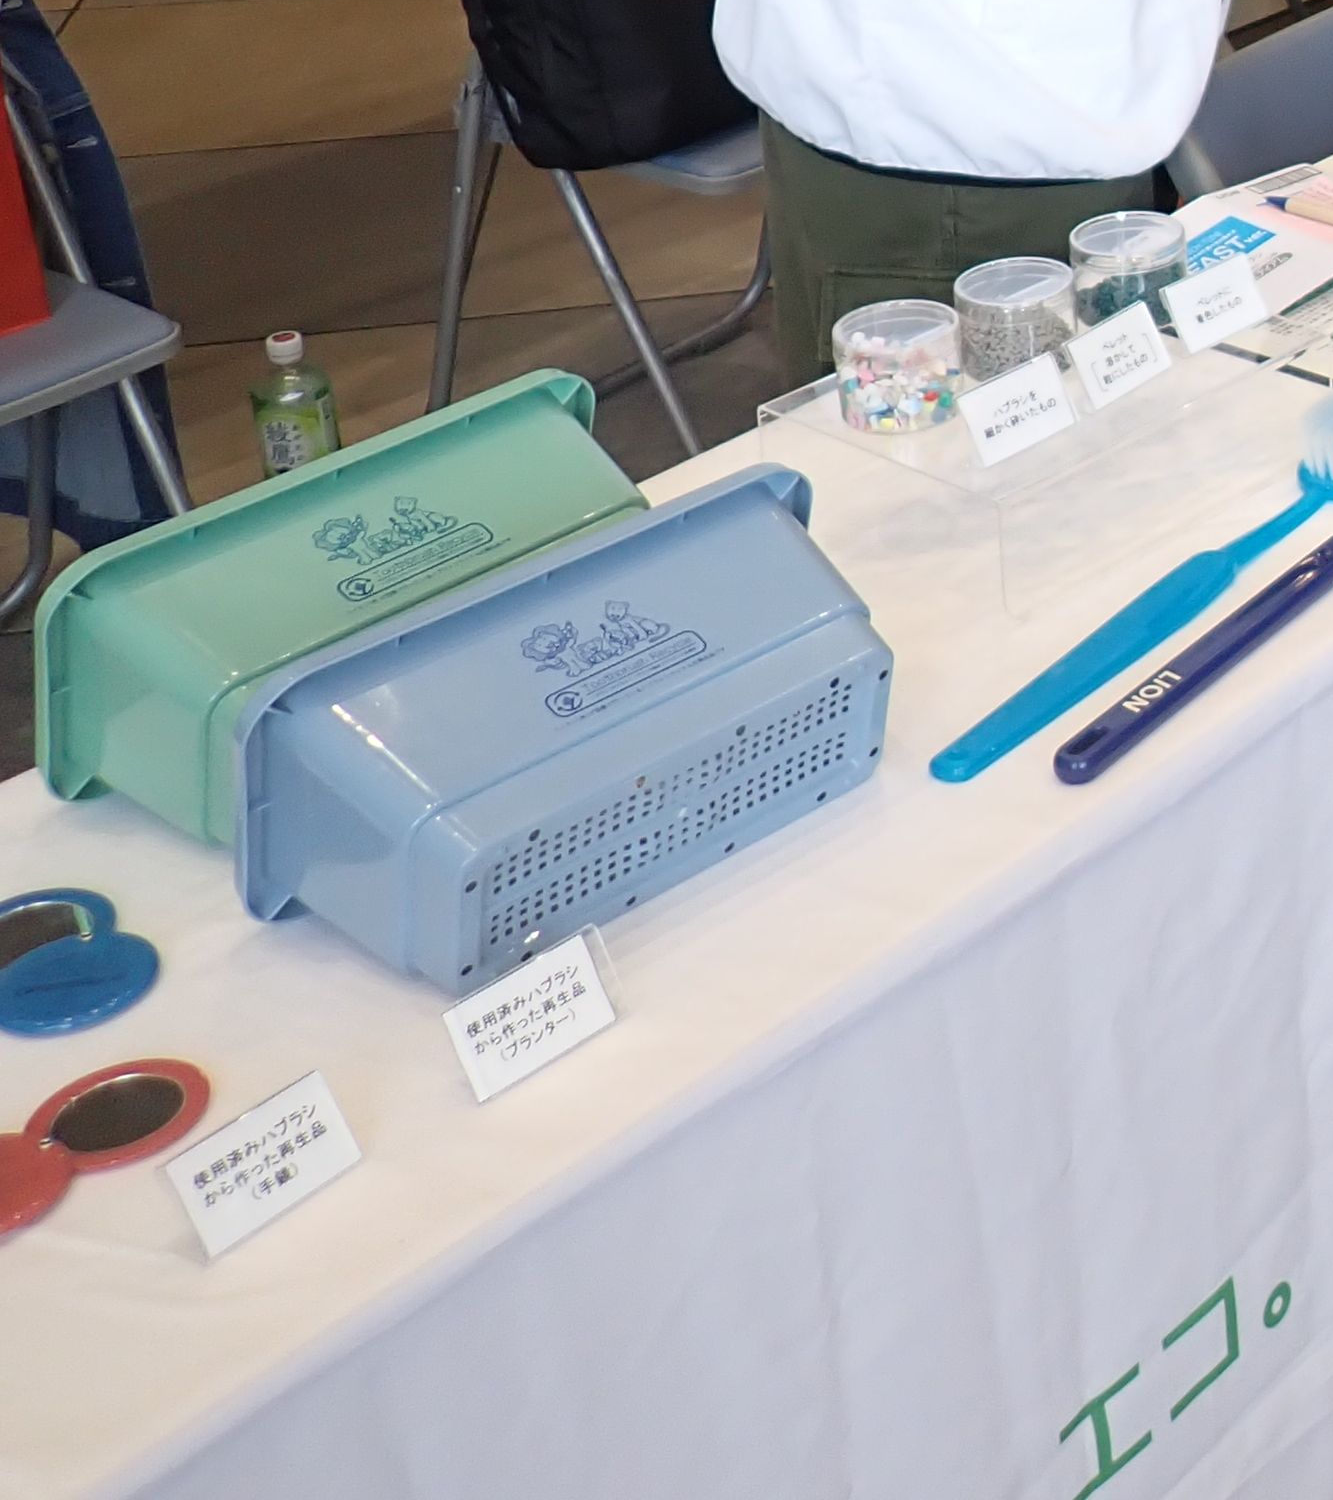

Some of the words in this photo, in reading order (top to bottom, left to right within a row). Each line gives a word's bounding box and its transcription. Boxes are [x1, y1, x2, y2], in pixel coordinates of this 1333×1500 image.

[1121, 669, 1182, 713] LION
[465, 965, 579, 1038] 使用済みハブラシ
[473, 980, 587, 1056] から作った再生品
[192, 1103, 317, 1190] 使用済みハブラシ
[203, 1119, 328, 1208] から作った再生品
